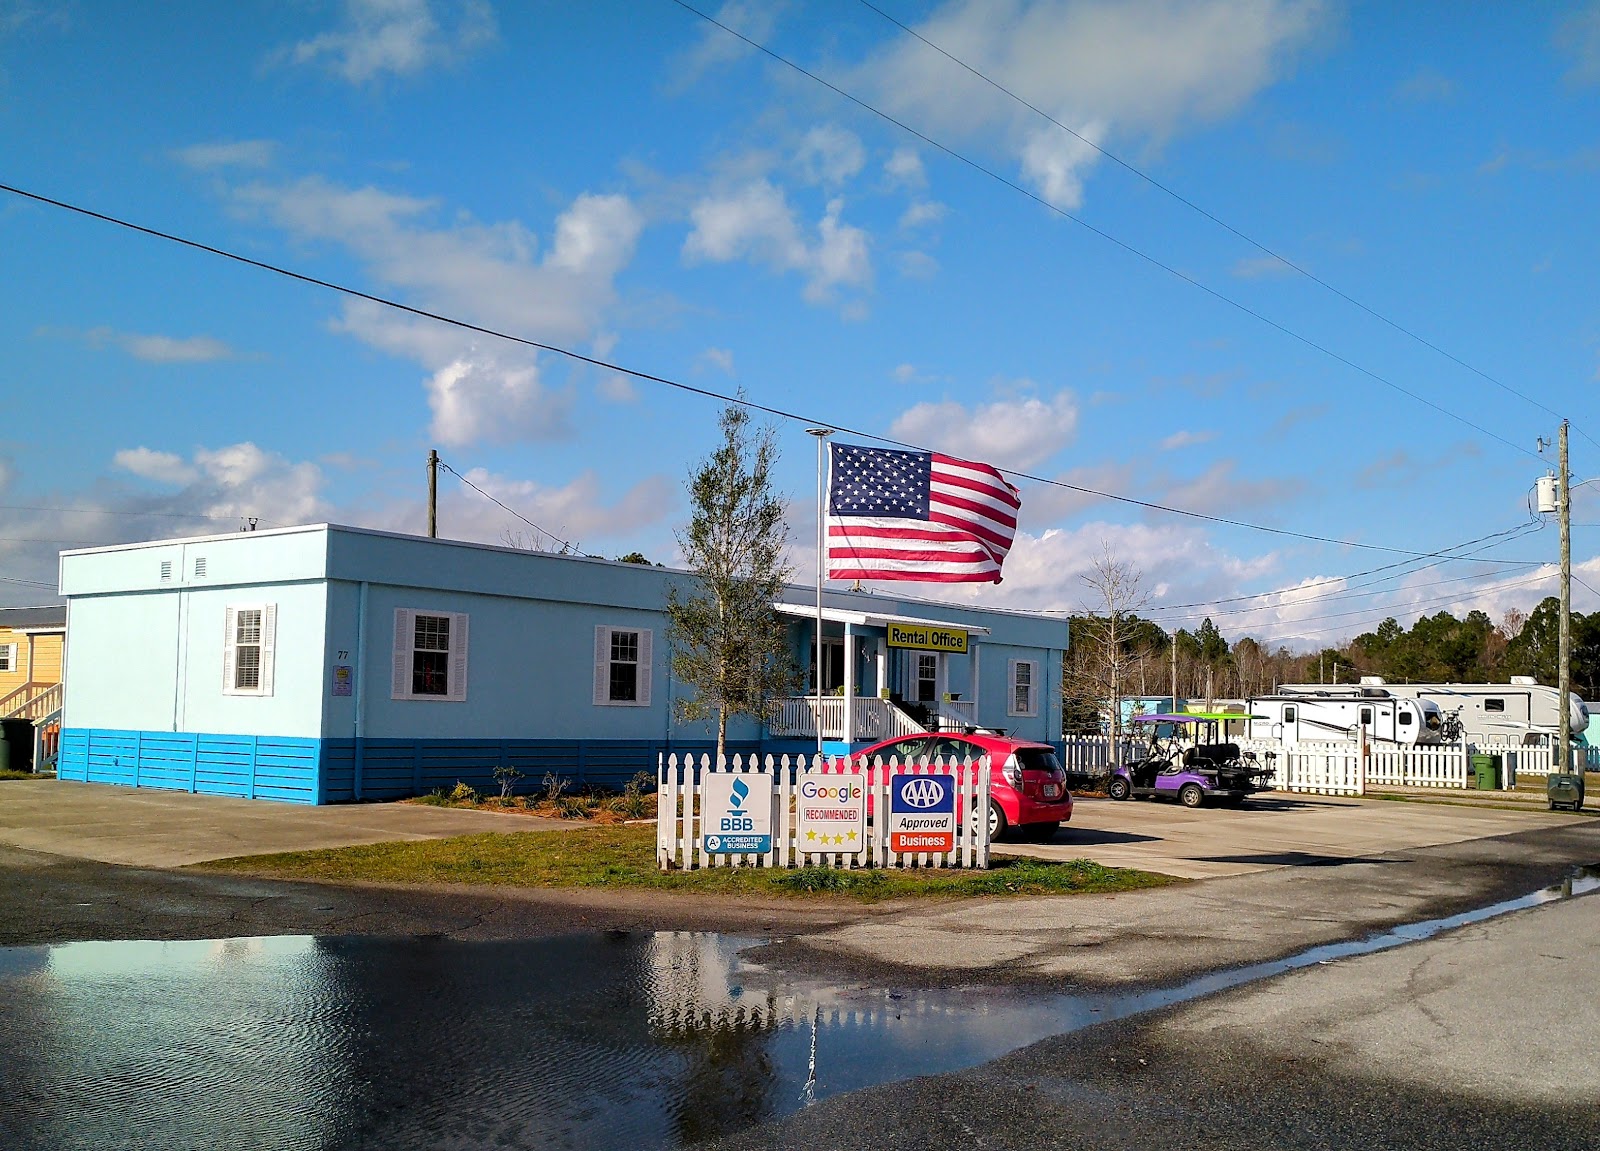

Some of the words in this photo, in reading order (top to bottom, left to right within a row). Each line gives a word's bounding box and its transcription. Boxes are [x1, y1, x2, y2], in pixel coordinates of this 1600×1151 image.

[892, 628, 928, 645] Rental
[931, 631, 963, 648] Office
[338, 650, 349, 660] 77
[802, 781, 861, 803] Google
[904, 779, 942, 807] AAA
[805, 809, 858, 820] RECOMMENDED
[720, 818, 753, 831] BBB
[899, 817, 948, 830] Approved
[899, 834, 946, 847] Business
